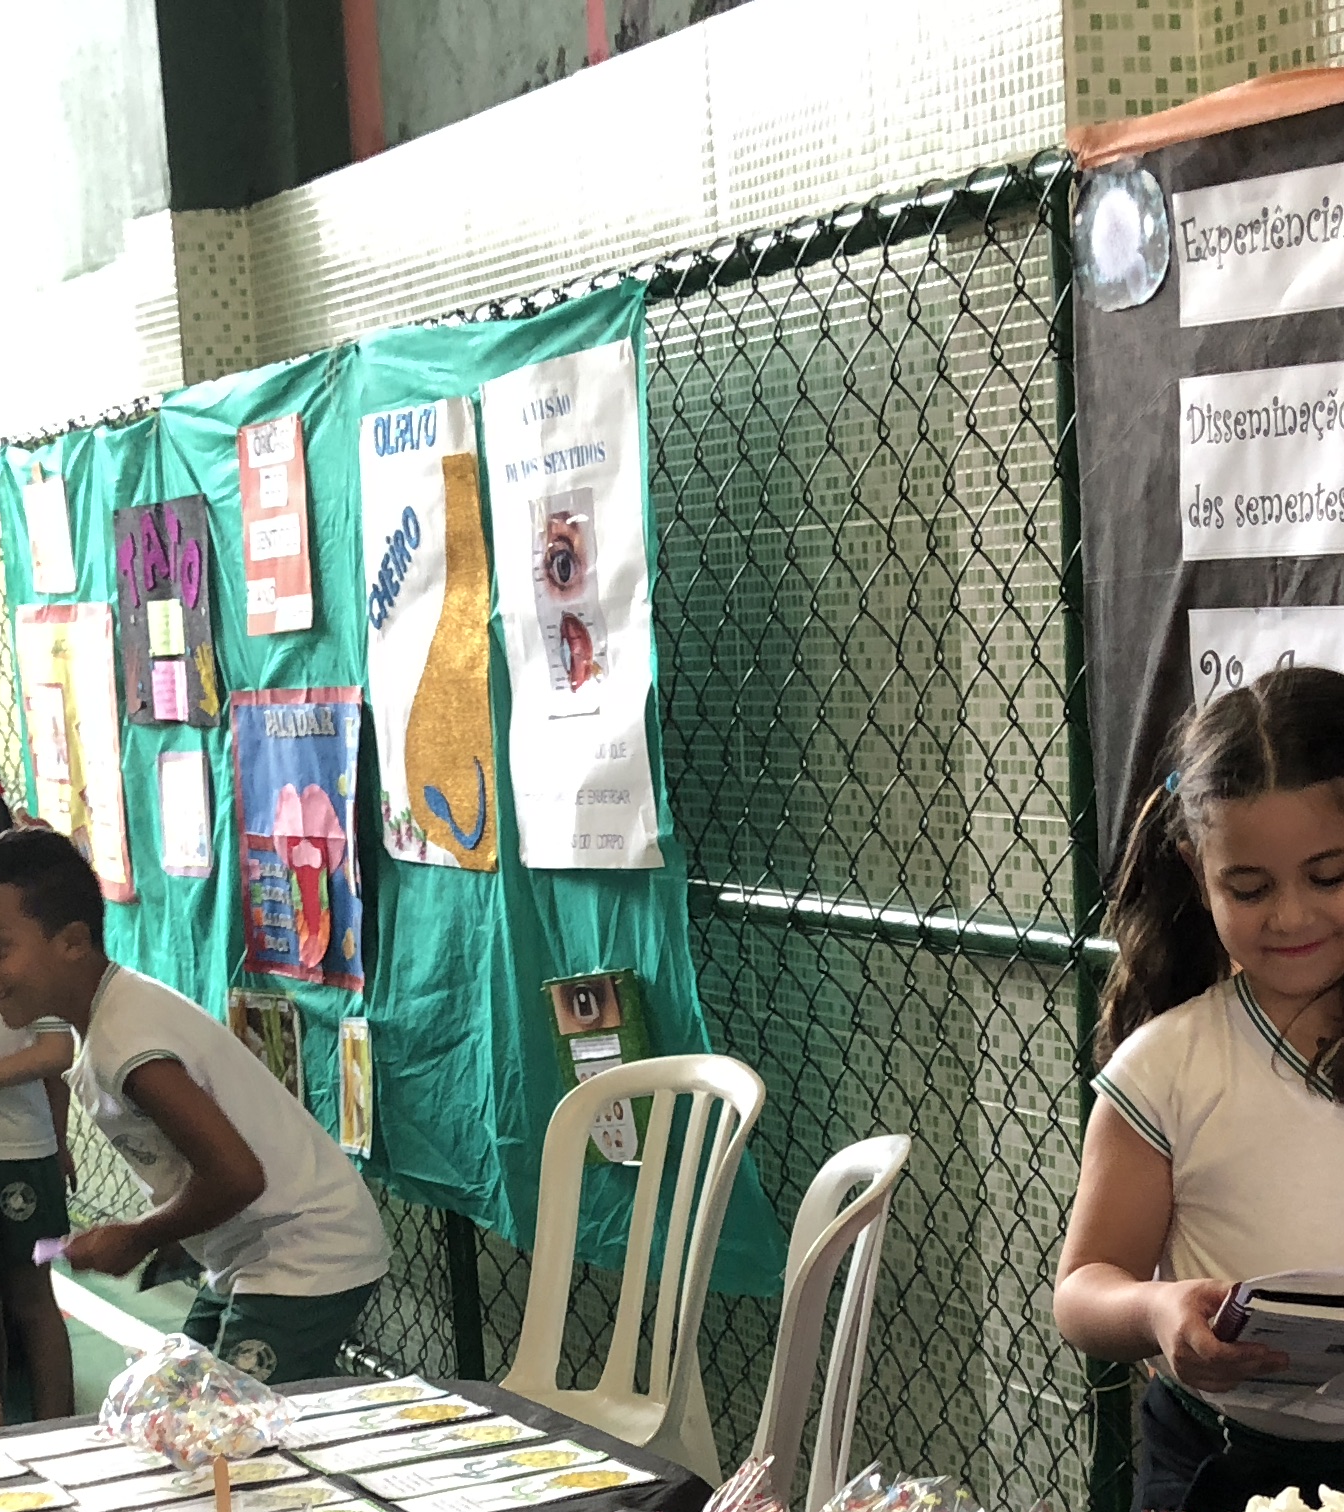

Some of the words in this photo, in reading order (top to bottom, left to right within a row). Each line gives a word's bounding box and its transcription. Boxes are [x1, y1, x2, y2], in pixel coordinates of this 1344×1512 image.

[1188, 483, 1225, 529] das
[116, 505, 203, 609] TATO
[263, 706, 336, 738] PALADAR
